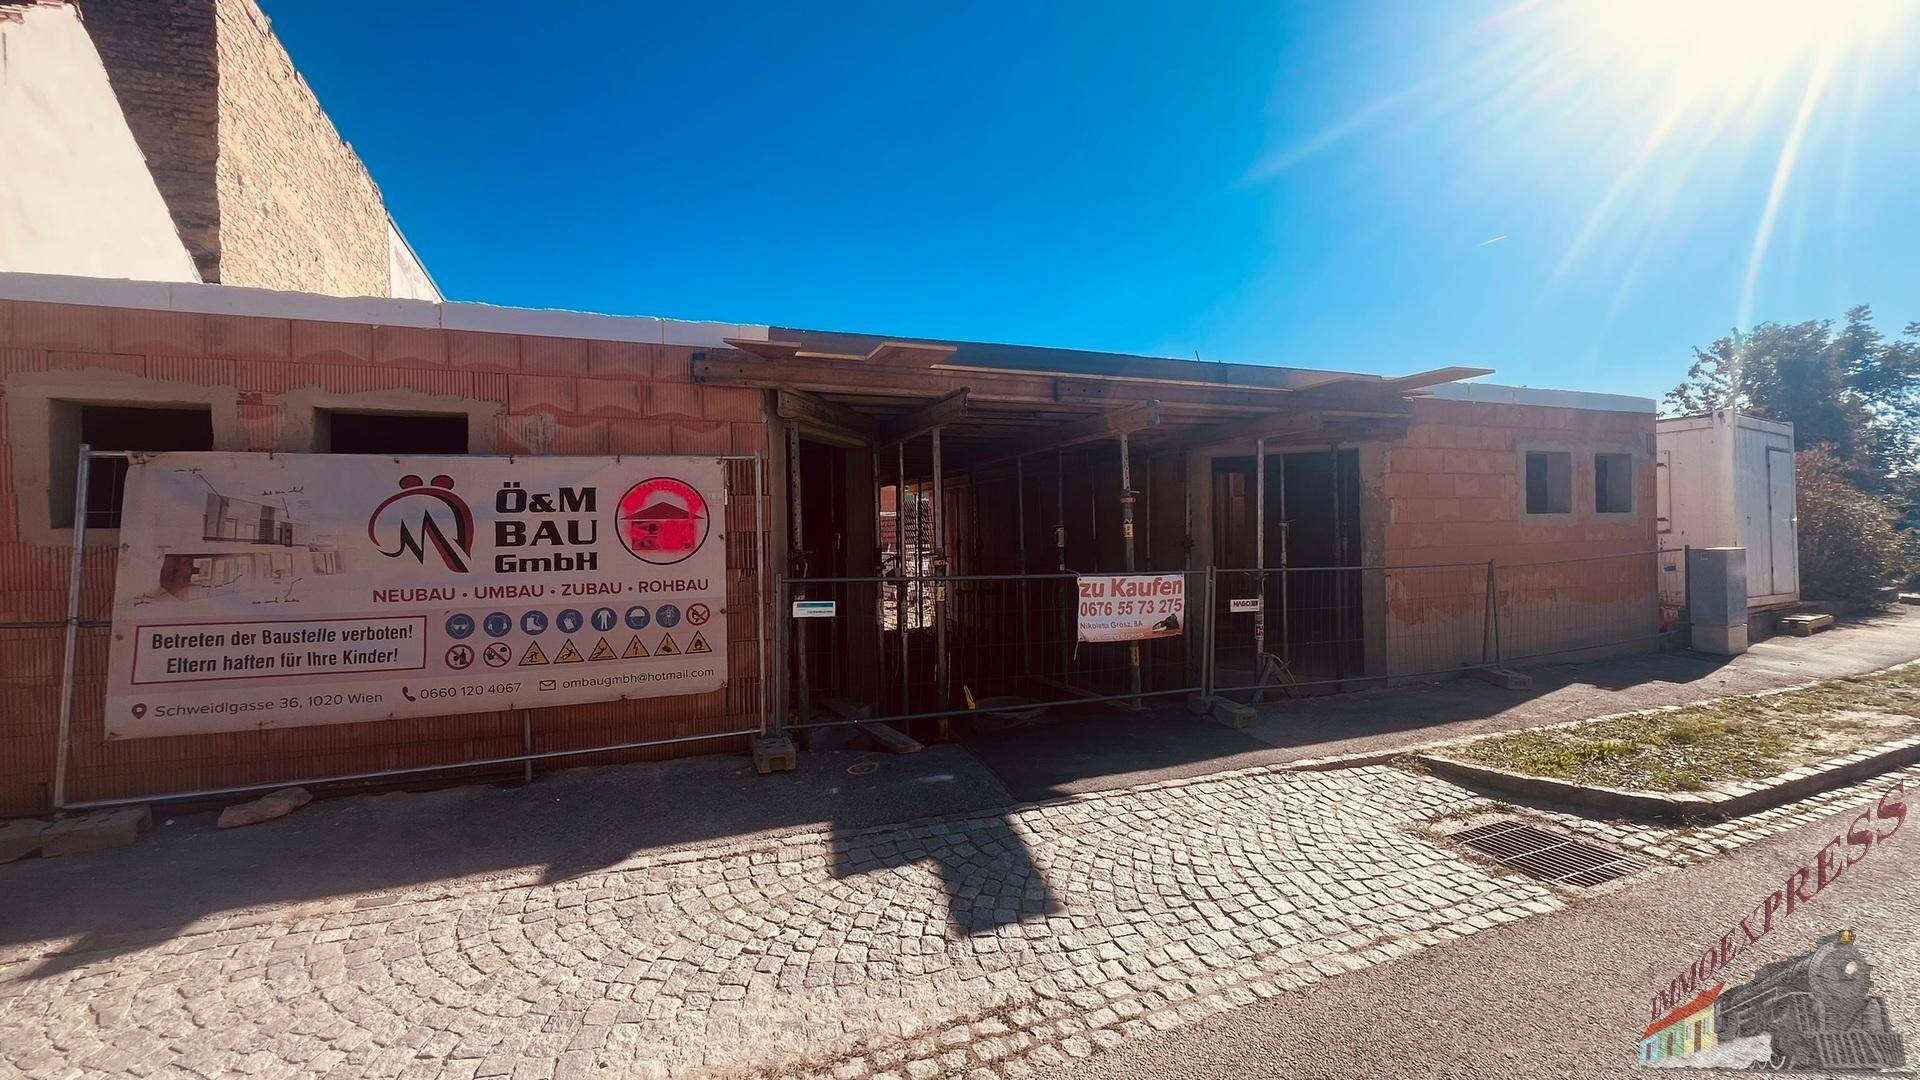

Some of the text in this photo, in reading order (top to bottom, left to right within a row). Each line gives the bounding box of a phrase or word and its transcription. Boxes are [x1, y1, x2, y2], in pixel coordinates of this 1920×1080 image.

[496, 481, 597, 514] Ö&M
[495, 519, 597, 547] BAU
[494, 552, 598, 573] GmbH
[373, 578, 709, 603] NEUBAU UMBAU ZUBAU ROHBAU
[1080, 577, 1183, 598] zu Kaufen
[1080, 598, 1182, 616] 0676 55 73 275
[152, 624, 413, 650] Betreten der Baustelle verboten!
[166, 648, 398, 673] Eltern haften für Ihre Kinder!
[420, 682, 521, 699] 0660 120 4067
[562, 667, 714, 690] ombaugmbh@hotmail.com
[155, 692, 383, 718] Schweidlgasse 36, 1020 Wien
